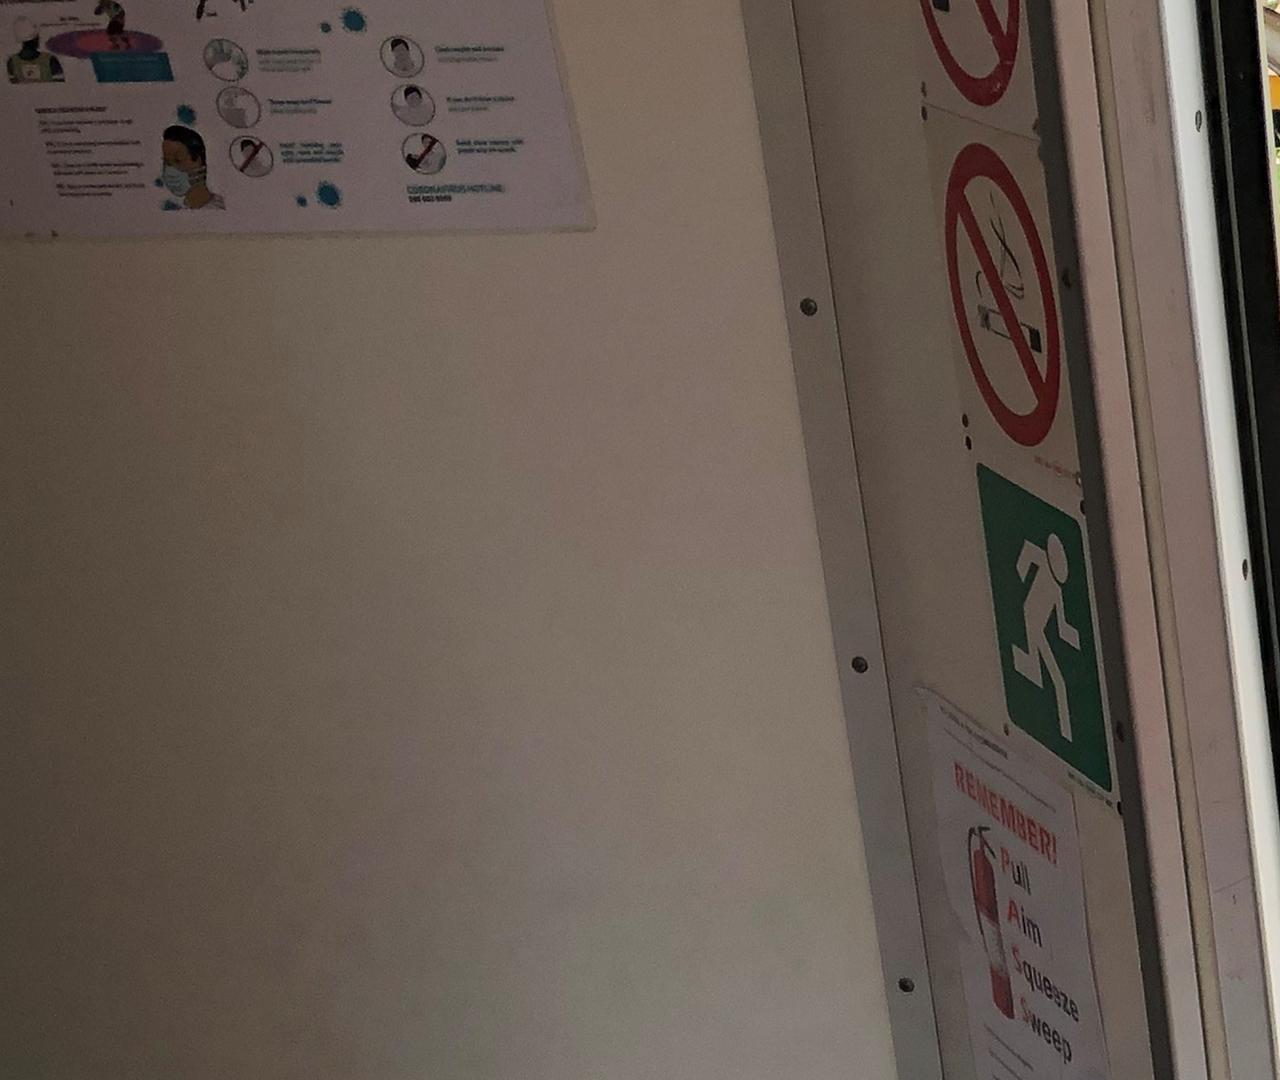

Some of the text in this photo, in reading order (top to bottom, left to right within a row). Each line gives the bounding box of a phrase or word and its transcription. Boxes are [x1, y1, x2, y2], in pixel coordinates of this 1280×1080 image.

[952, 760, 1058, 866] REMEMBER!
[999, 846, 1032, 896] Pull
[1006, 896, 1043, 948] Aim
[1011, 943, 1080, 1024] Squeeze
[1019, 996, 1074, 1066] Sweep
